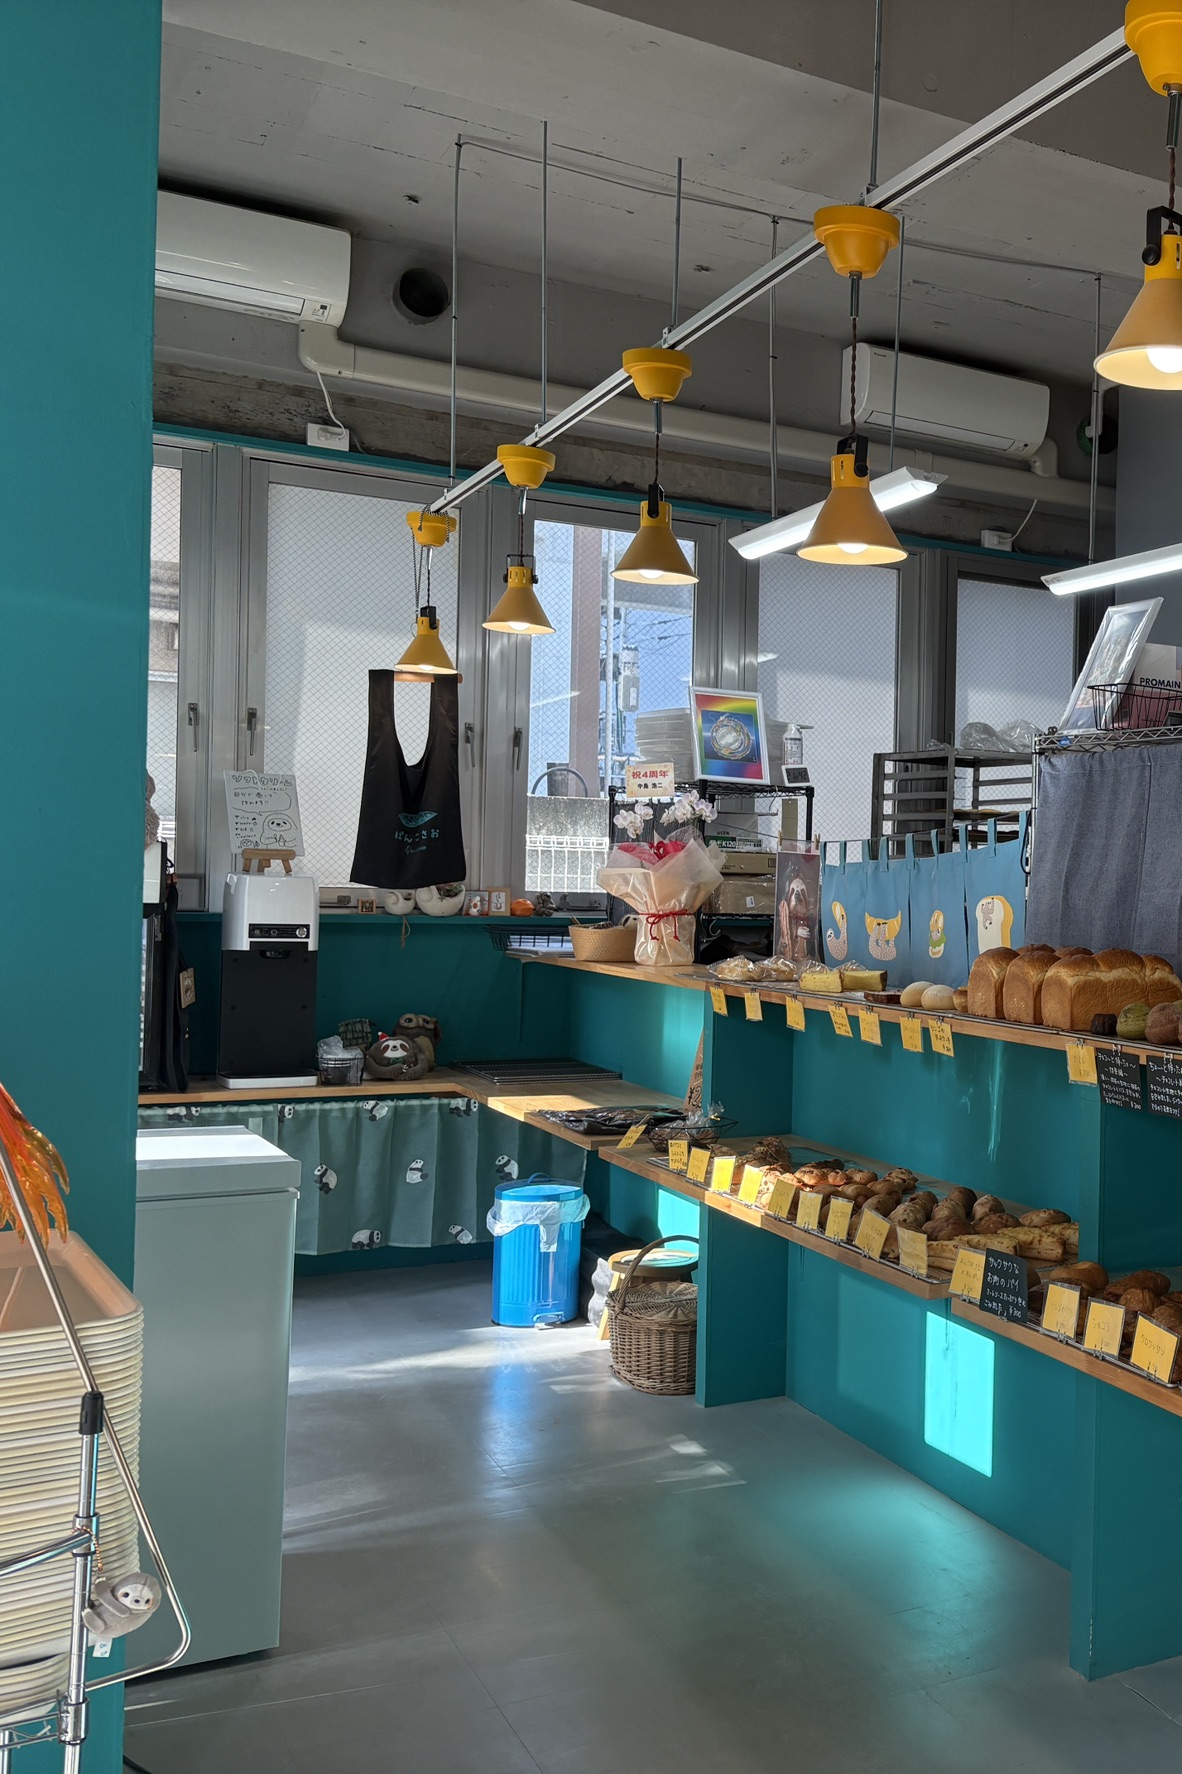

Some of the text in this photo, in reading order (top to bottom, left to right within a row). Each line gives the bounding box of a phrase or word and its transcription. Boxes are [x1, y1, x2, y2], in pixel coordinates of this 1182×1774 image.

[1140, 677, 1181, 689] PROMAIN
[232, 775, 292, 786] ソフトクリーム
[632, 770, 669, 779] 祝4周年
[987, 1272, 1019, 1291] お肉のパイ
[1141, 1334, 1165, 1356] クロワッサン
